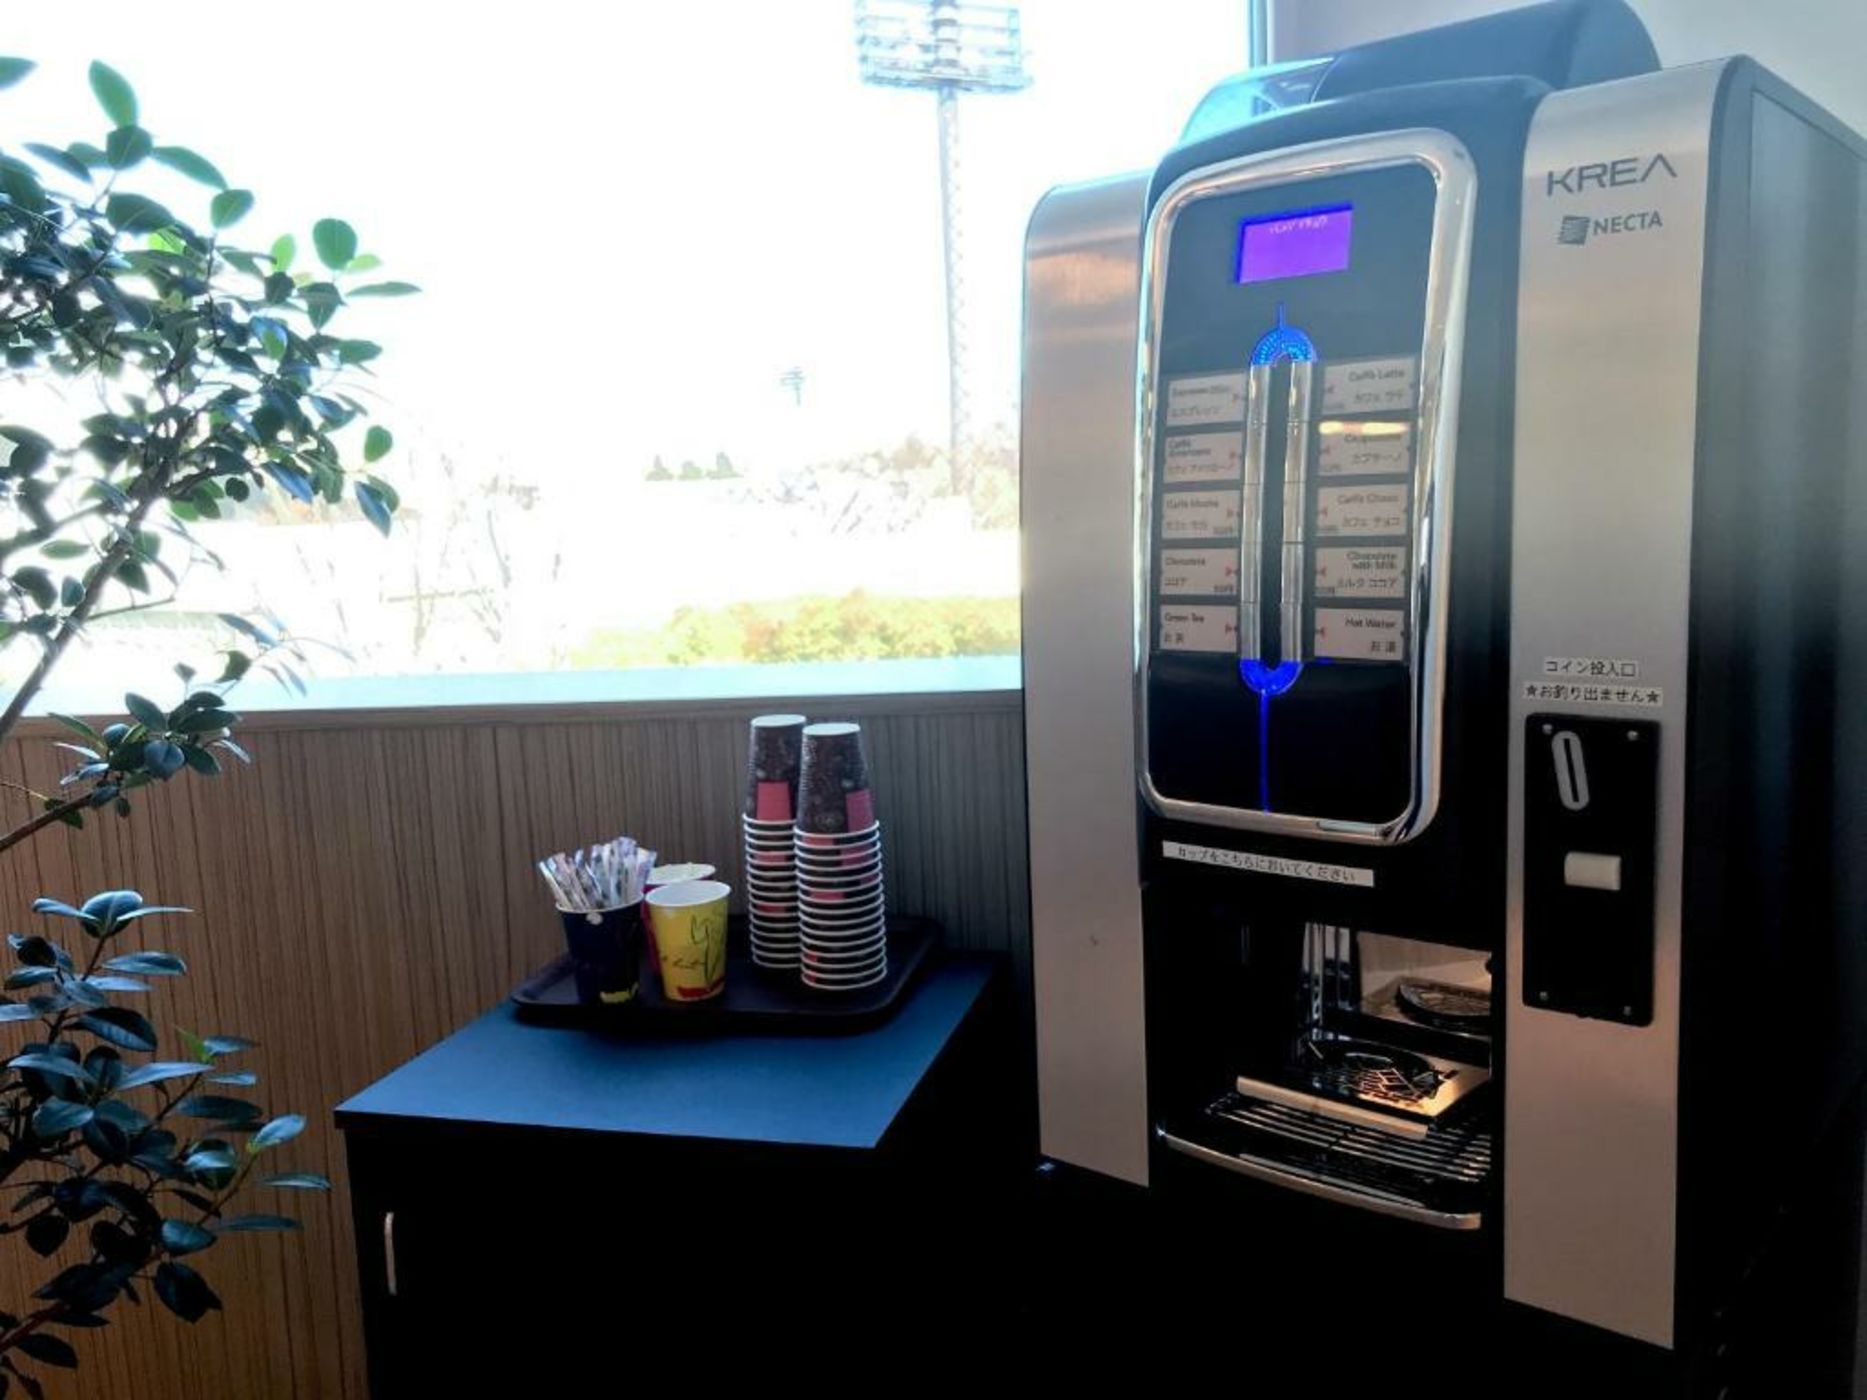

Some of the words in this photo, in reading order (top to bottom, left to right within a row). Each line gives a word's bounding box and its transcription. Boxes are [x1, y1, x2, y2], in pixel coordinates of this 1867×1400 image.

[1547, 153, 1677, 197] KREA
[1593, 210, 1662, 235] NECTA
[1164, 612, 1189, 624] Green
[1191, 612, 1205, 624] Tea
[1345, 617, 1363, 629] Hot
[1365, 617, 1397, 630] Water
[1546, 660, 1636, 678] コイン投入口
